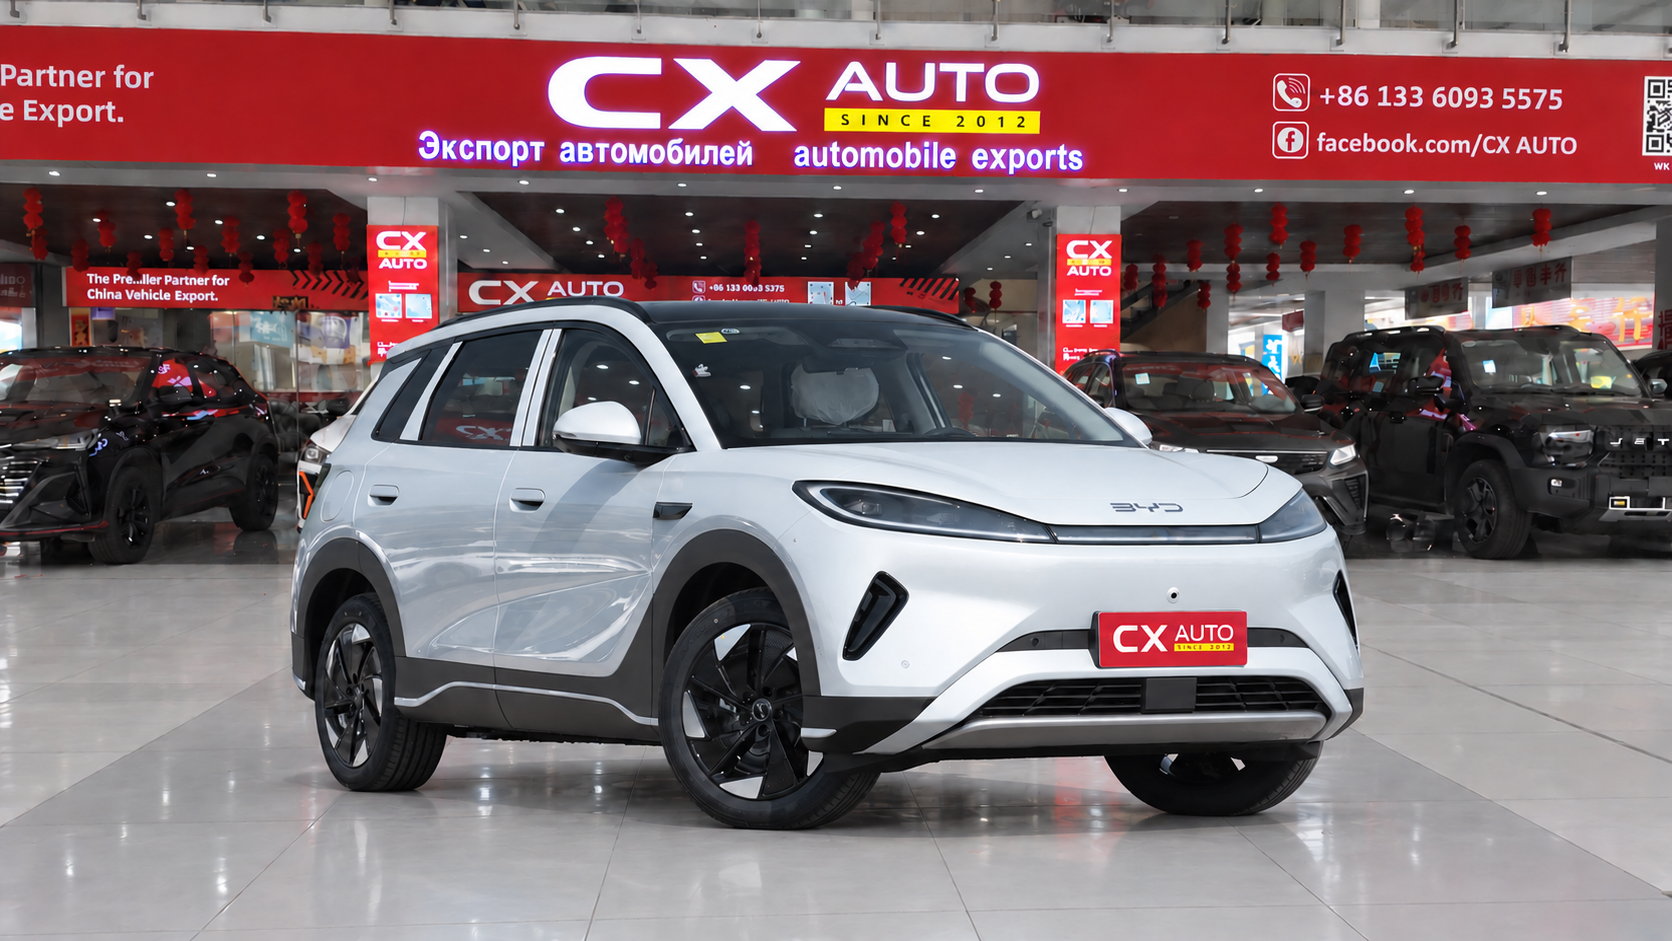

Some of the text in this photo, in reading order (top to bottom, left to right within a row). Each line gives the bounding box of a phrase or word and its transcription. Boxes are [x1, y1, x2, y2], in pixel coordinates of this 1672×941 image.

[0, 64, 154, 89] Partner for
[548, 56, 1039, 132] CX AUTO
[1320, 85, 1563, 110] +86 133 6093 5575
[23, 100, 124, 128] Export.
[841, 114, 1025, 128] SINCE 2012
[418, 130, 753, 166] Экспорт автомобилей
[1316, 132, 1577, 157] facebook.com/CX AUTO
[794, 141, 1083, 174] automobile exports
[376, 231, 427, 250] CX
[1066, 240, 1113, 259] CX
[378, 258, 428, 270] AUTO
[1066, 265, 1112, 276] AUTO
[86, 273, 110, 284] The
[164, 275, 209, 286] Partner
[212, 275, 230, 286] for
[726, 284, 741, 292] 133
[87, 288, 218, 303] China Vehicle Export.
[468, 280, 624, 305] CX AUTO
[1110, 503, 1183, 512] BYD
[1113, 624, 1234, 652] CX AUTO
